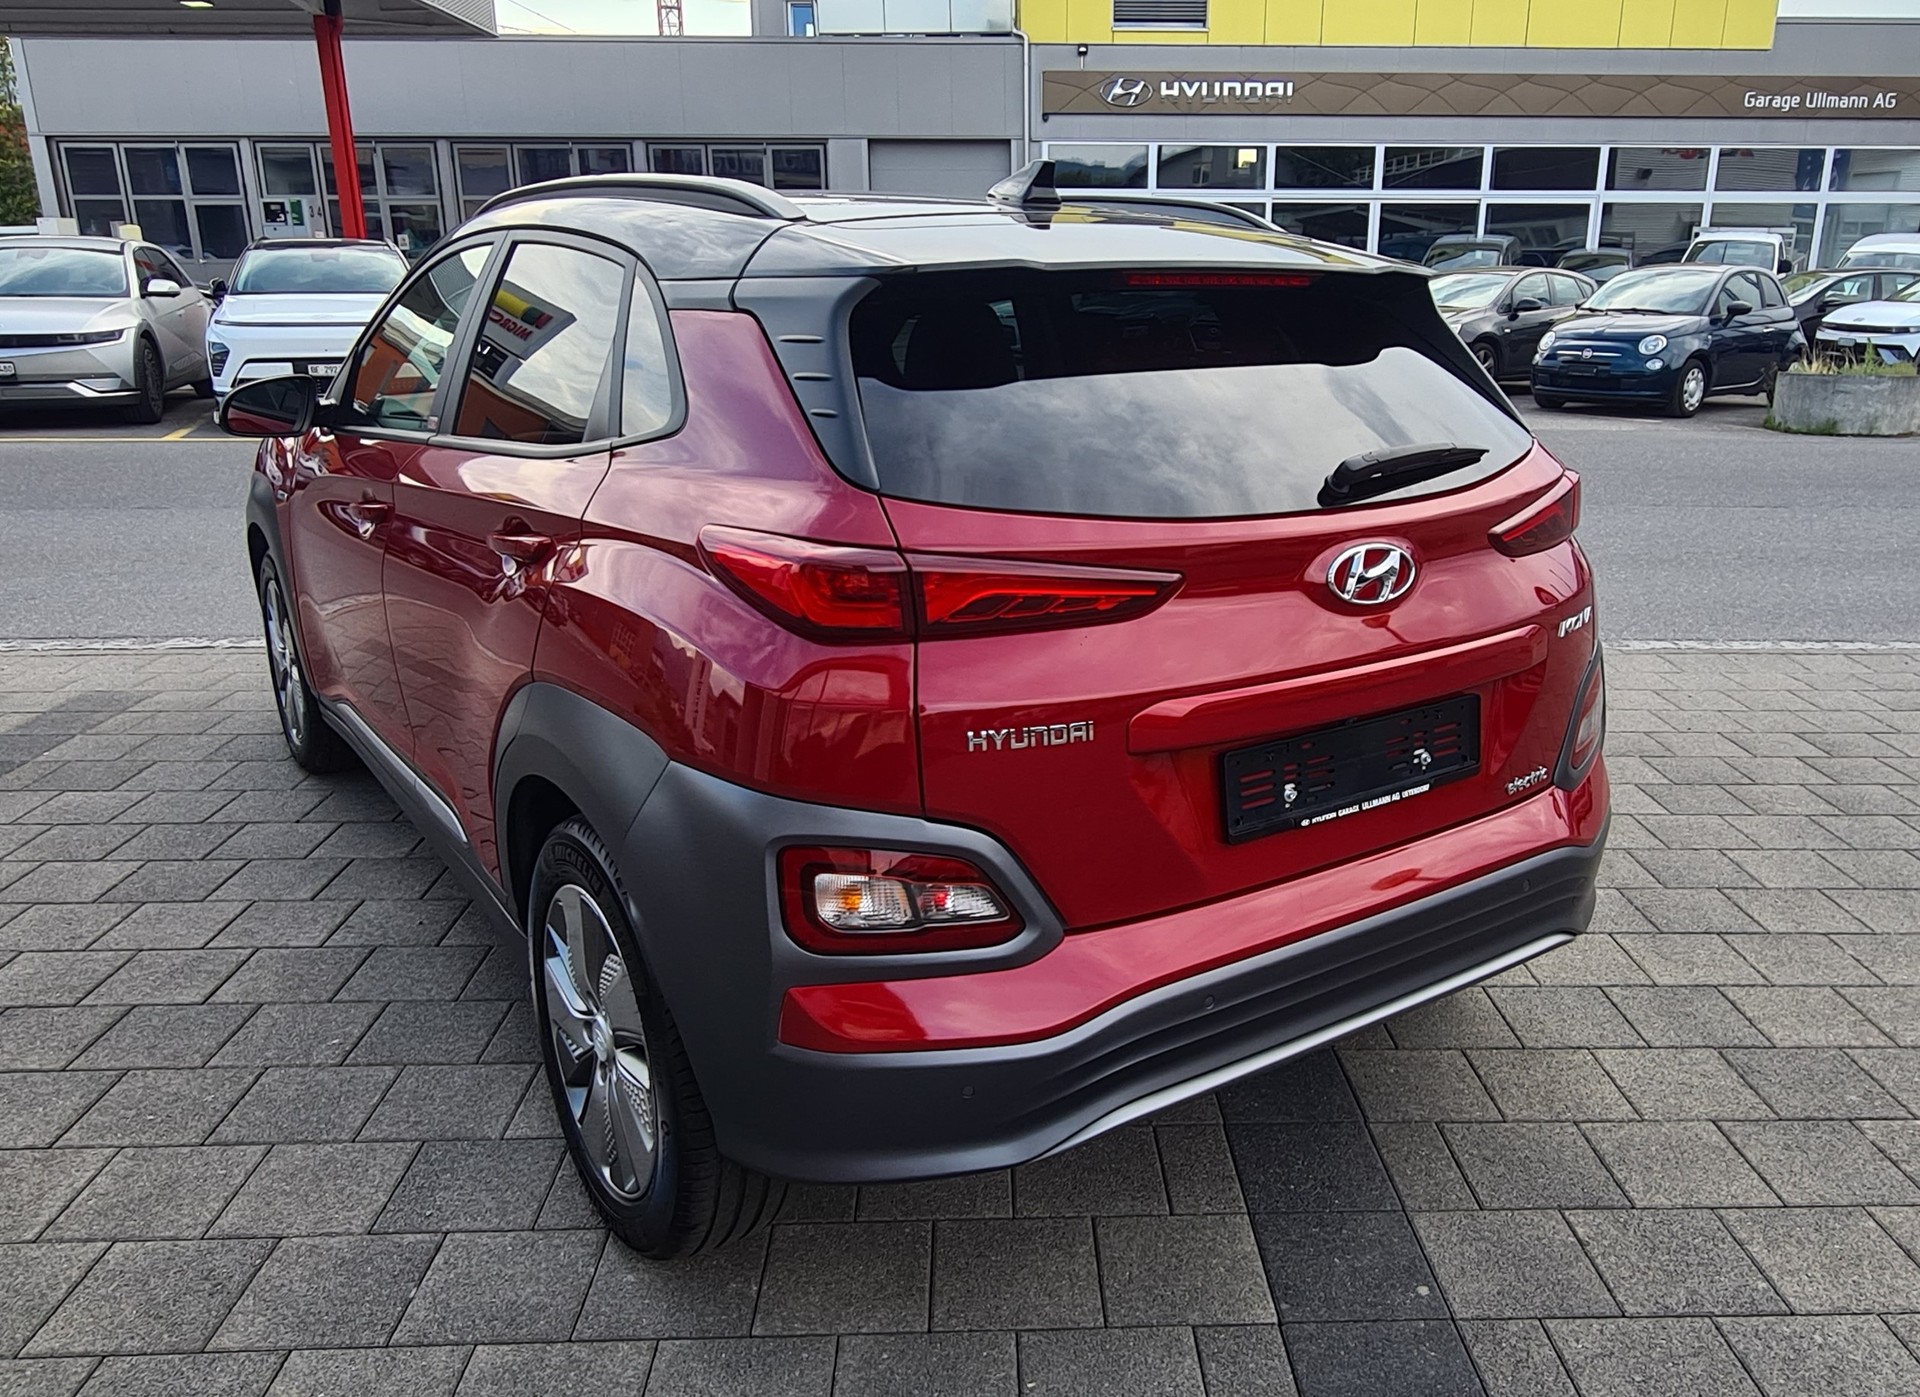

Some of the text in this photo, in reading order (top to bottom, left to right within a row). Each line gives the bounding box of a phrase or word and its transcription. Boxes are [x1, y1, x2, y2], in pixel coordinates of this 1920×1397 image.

[1160, 81, 1294, 104] HYUNDAI
[1744, 91, 1897, 112] Garage Ullmann AG
[966, 720, 1094, 753] HYUNDAI
[1505, 765, 1548, 796] electric
[1338, 804, 1360, 818] GARAGE
[1361, 794, 1391, 811] ULLMANN
[1391, 791, 1401, 802] AG
[553, 844, 606, 898] MICHELIN
